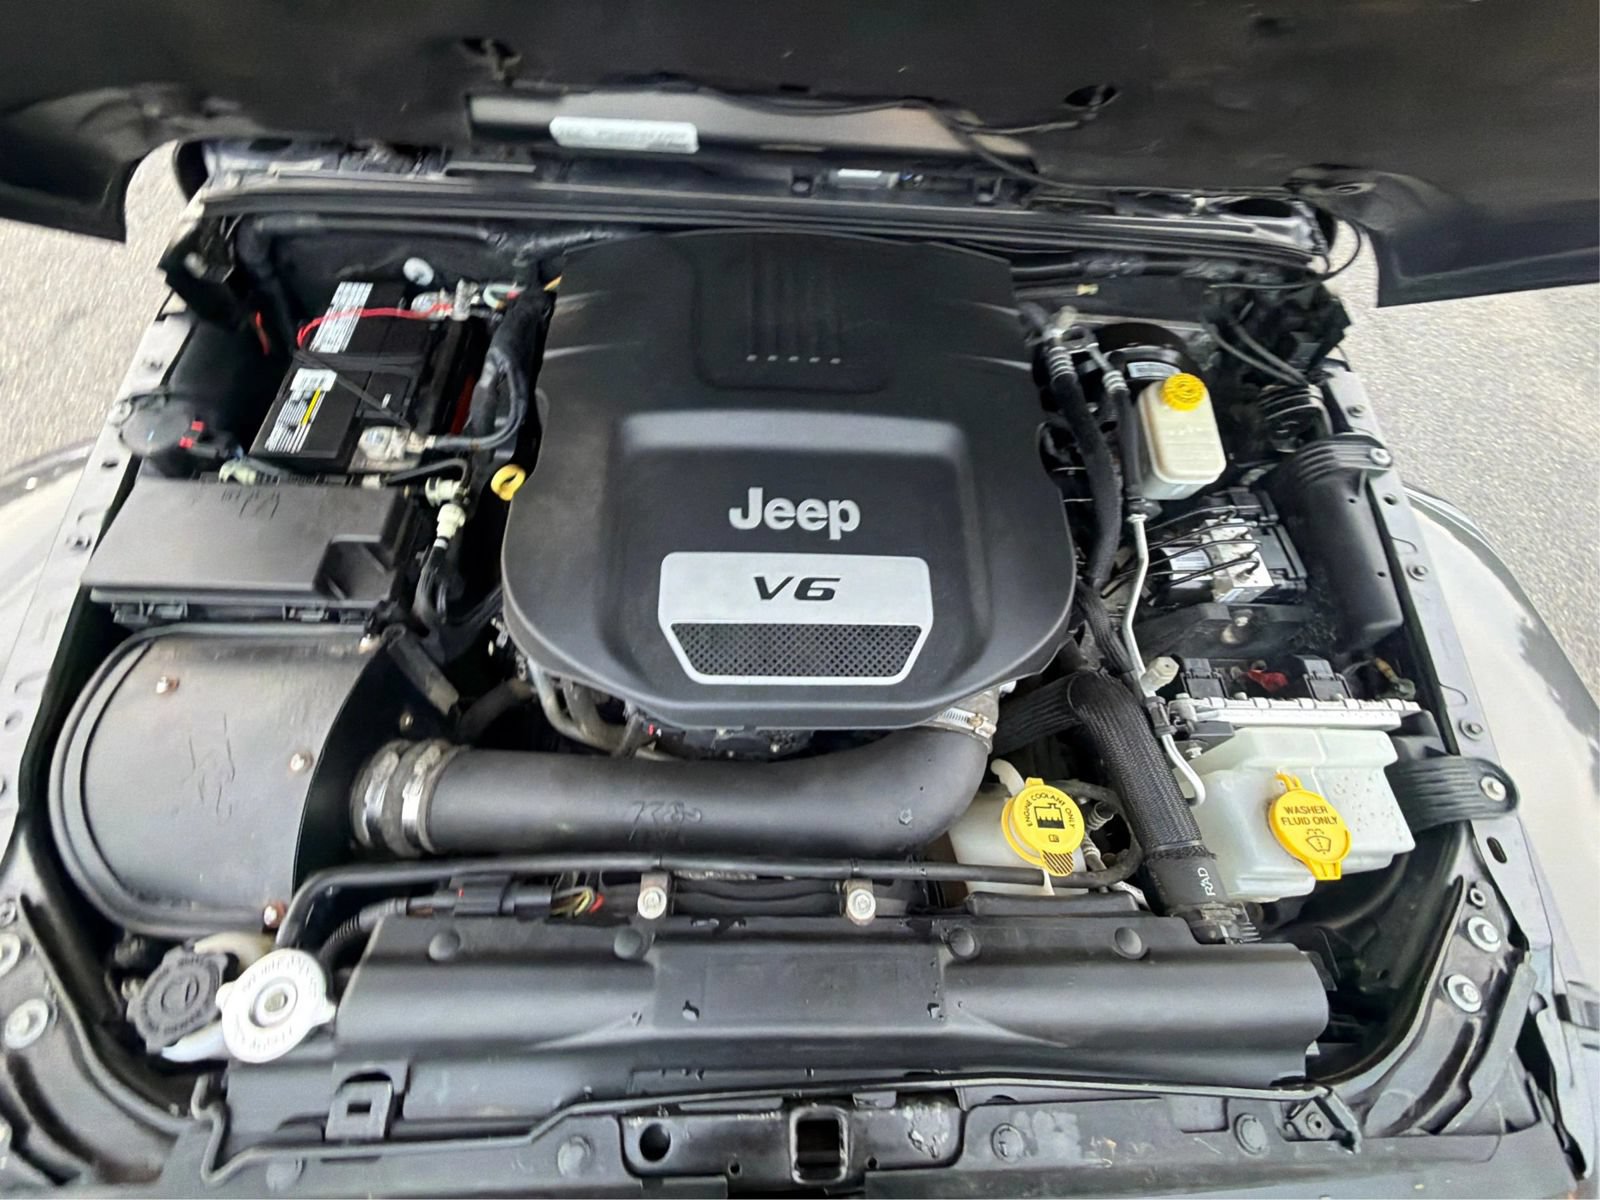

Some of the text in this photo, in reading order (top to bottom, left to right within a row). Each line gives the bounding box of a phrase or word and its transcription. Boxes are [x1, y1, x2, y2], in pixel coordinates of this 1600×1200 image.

[728, 487, 861, 540] Jeep
[753, 576, 841, 601] V6
[1023, 792, 1076, 829] ENGINE COOLANT ONLY
[1281, 816, 1338, 826] FLUID ONLY
[1283, 806, 1329, 815] WASHER
[1197, 867, 1217, 896] RAD
